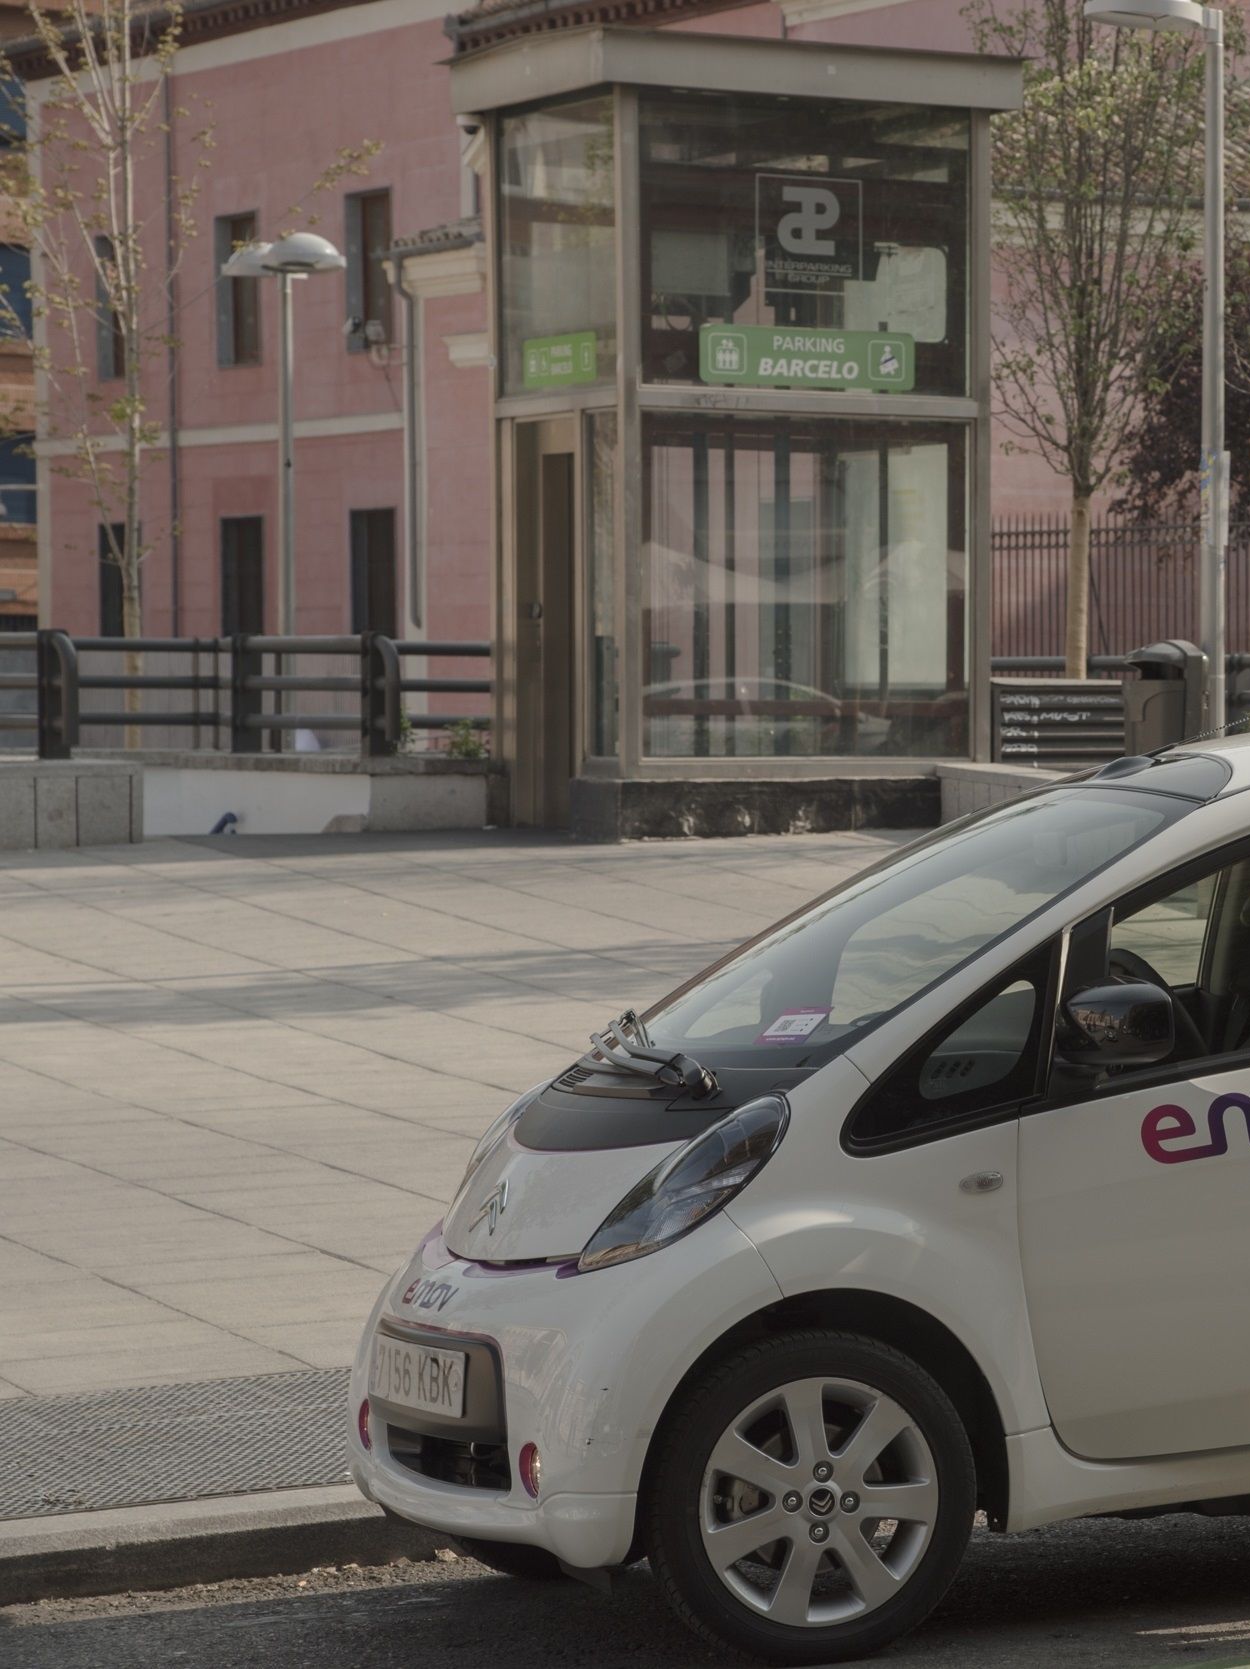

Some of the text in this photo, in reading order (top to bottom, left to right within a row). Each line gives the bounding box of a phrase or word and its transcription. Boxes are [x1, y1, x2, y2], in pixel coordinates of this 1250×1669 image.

[787, 273, 831, 283] GROUP
[773, 335, 845, 354] PARKING
[758, 357, 860, 379] BARCELO
[402, 1278, 460, 1312] emov
[376, 1344, 455, 1407] 7156 KBK
